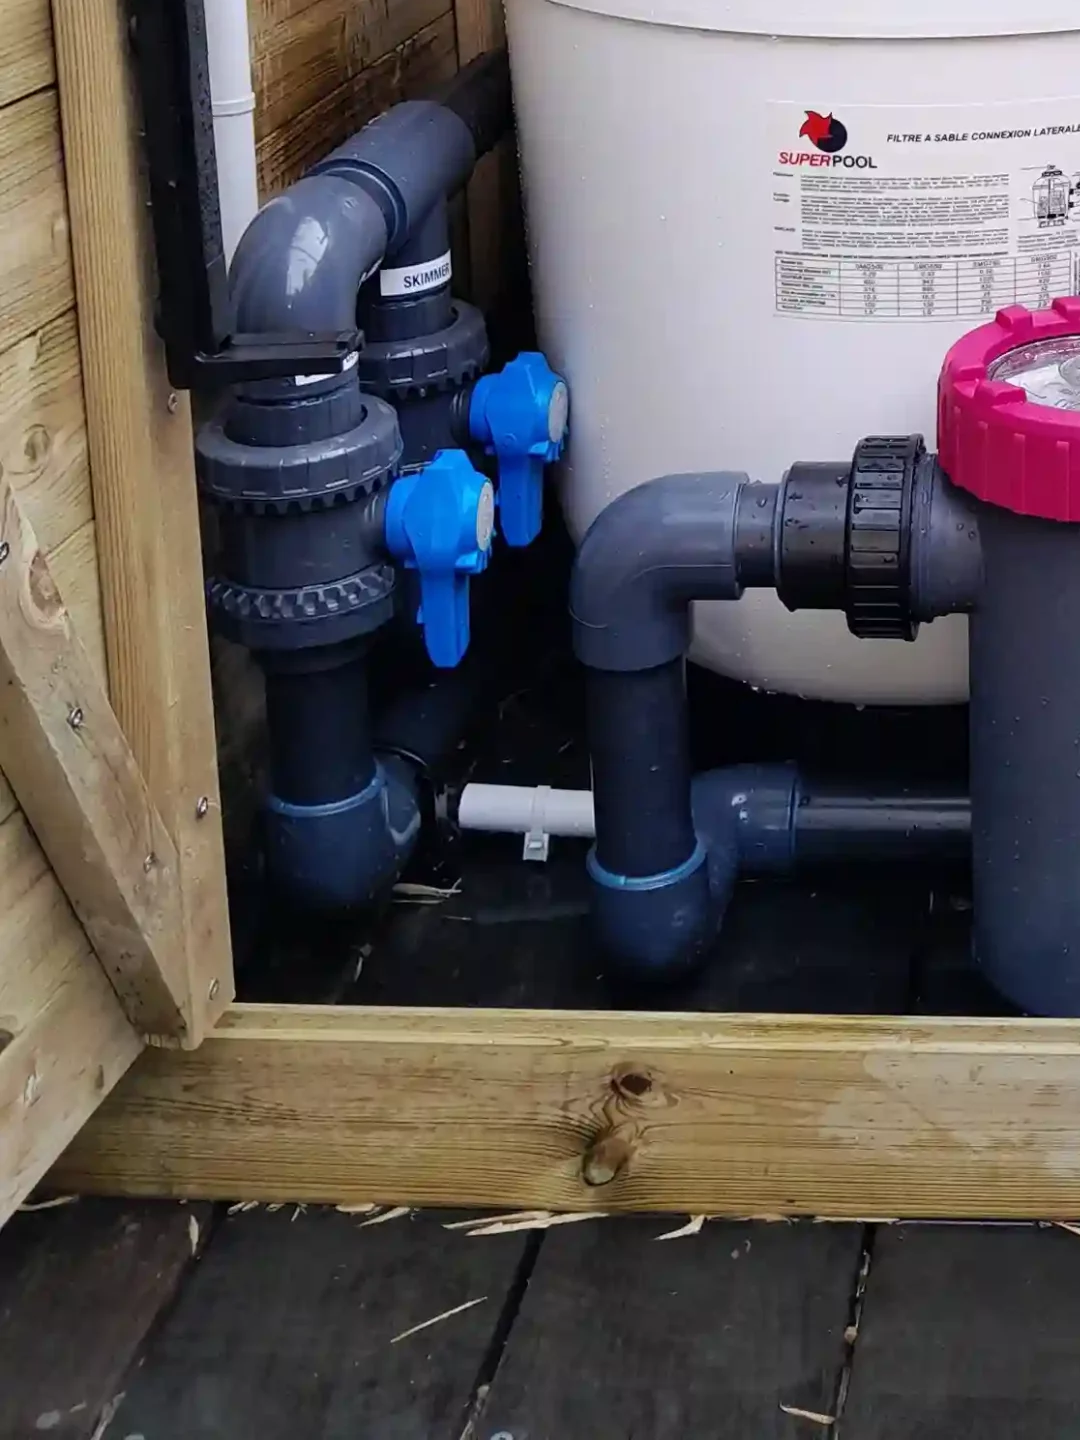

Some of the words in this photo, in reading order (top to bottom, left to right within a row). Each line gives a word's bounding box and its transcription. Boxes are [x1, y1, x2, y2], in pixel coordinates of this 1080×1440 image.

[887, 134, 922, 143] FILTRE
[924, 134, 932, 142] A
[934, 133, 969, 142] SABLE
[971, 129, 1032, 141] CONNEXION
[403, 262, 450, 289] SKIMMER
